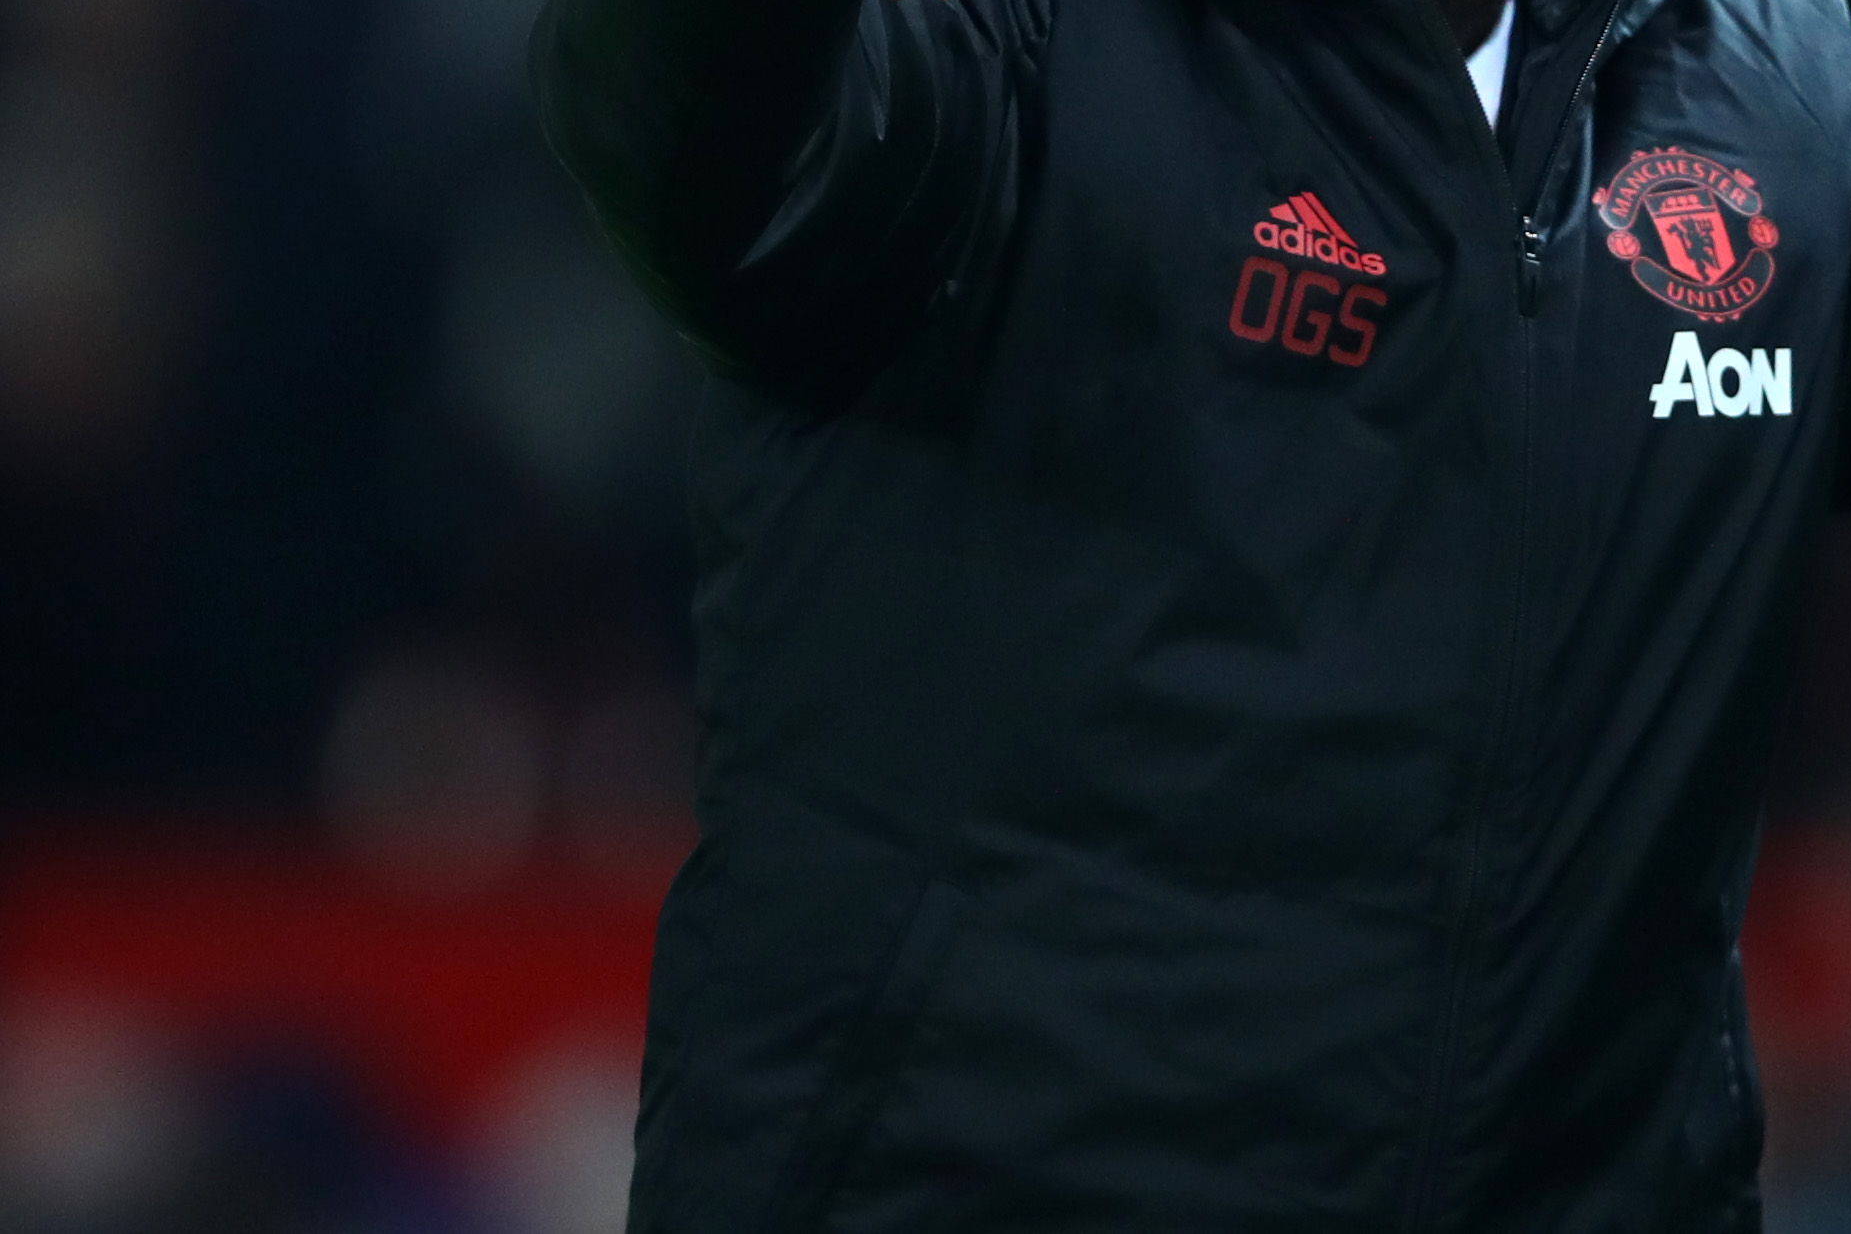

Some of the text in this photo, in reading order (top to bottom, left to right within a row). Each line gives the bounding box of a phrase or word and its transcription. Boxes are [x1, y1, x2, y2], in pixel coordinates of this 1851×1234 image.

[1611, 160, 1747, 217] MANCHESTER
[1253, 221, 1388, 276] adidas
[1229, 256, 1388, 368] OGS
[1667, 277, 1757, 307] UNITED
